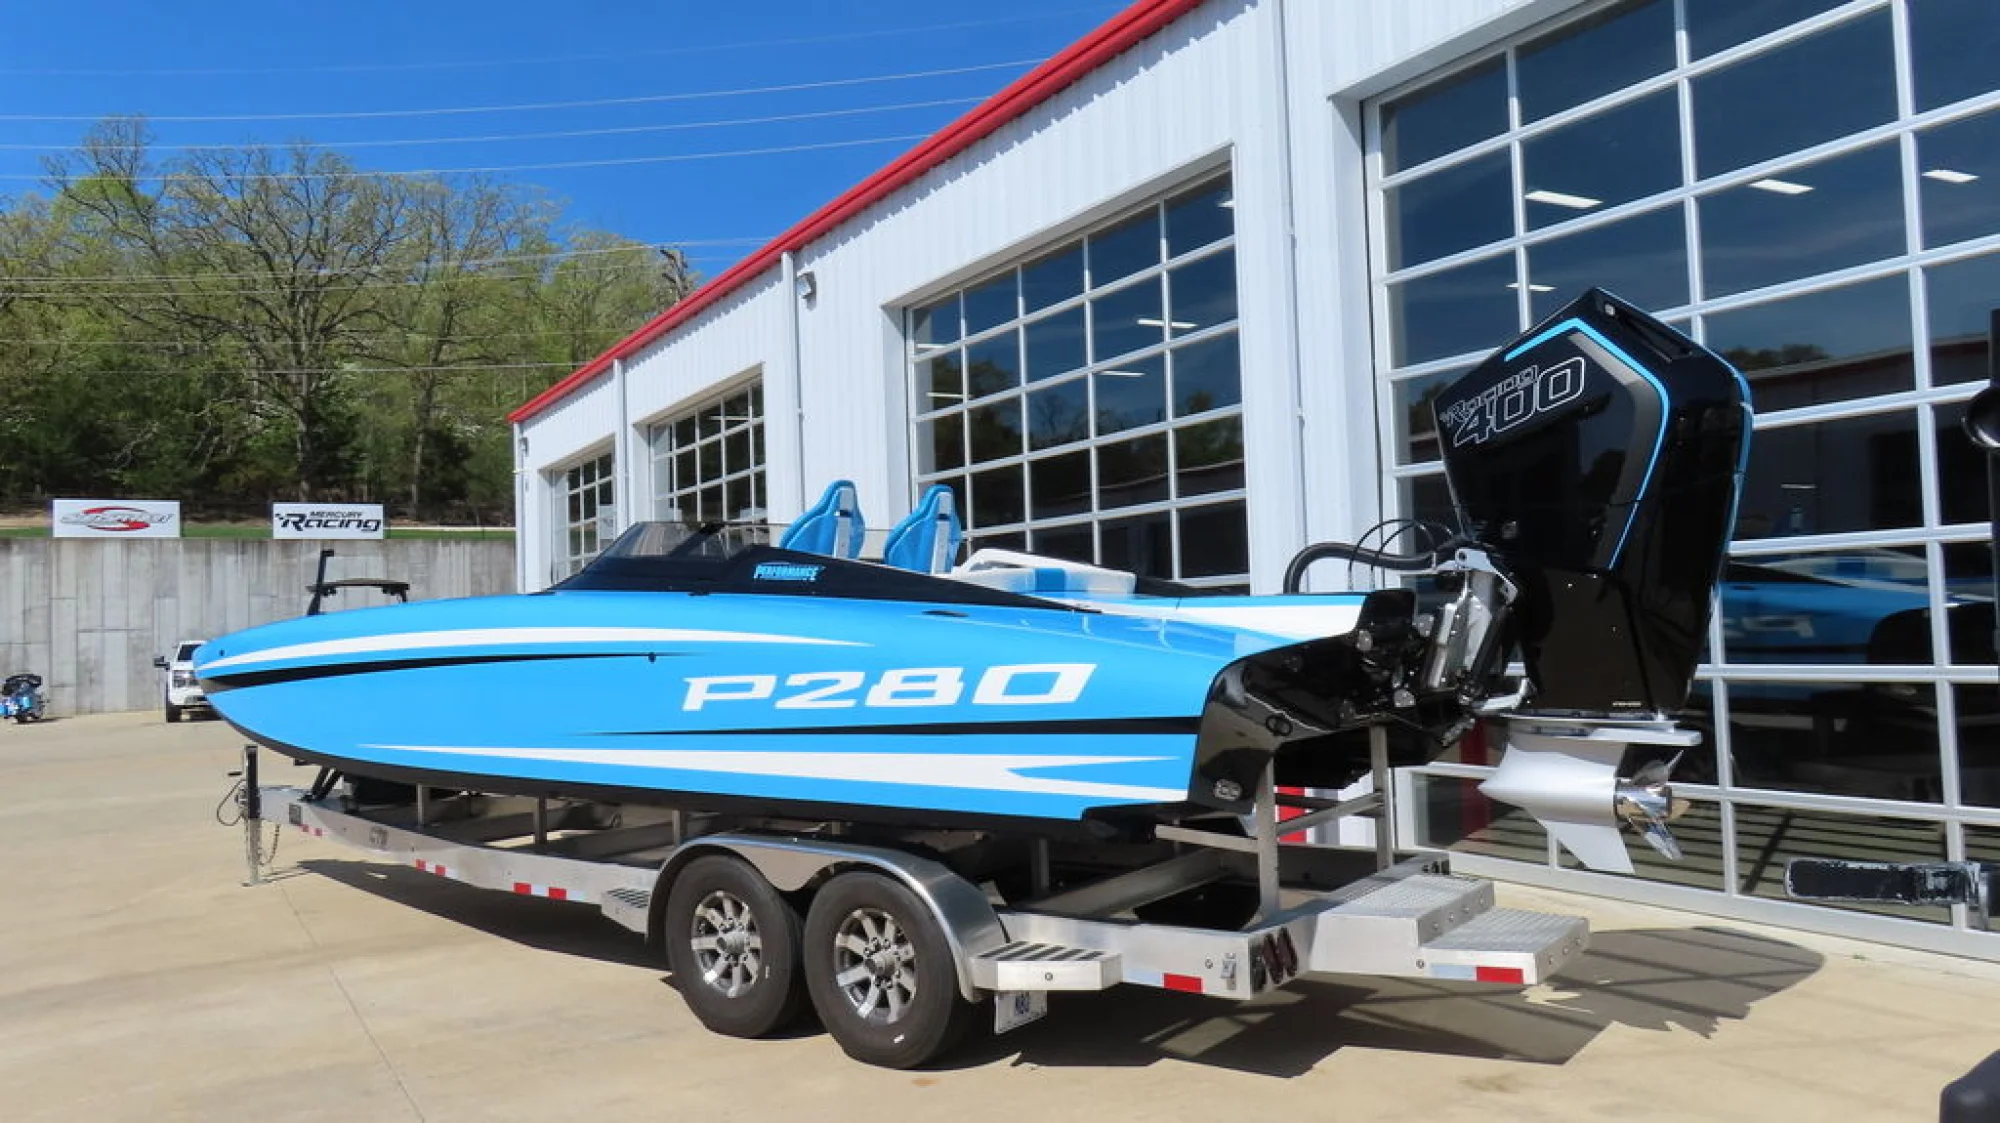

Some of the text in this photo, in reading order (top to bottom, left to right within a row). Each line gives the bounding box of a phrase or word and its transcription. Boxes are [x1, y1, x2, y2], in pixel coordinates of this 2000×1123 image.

[1440, 364, 1537, 427] Racing
[1453, 356, 1585, 448] 400
[281, 513, 381, 531] Racing
[682, 663, 1097, 712] P280
